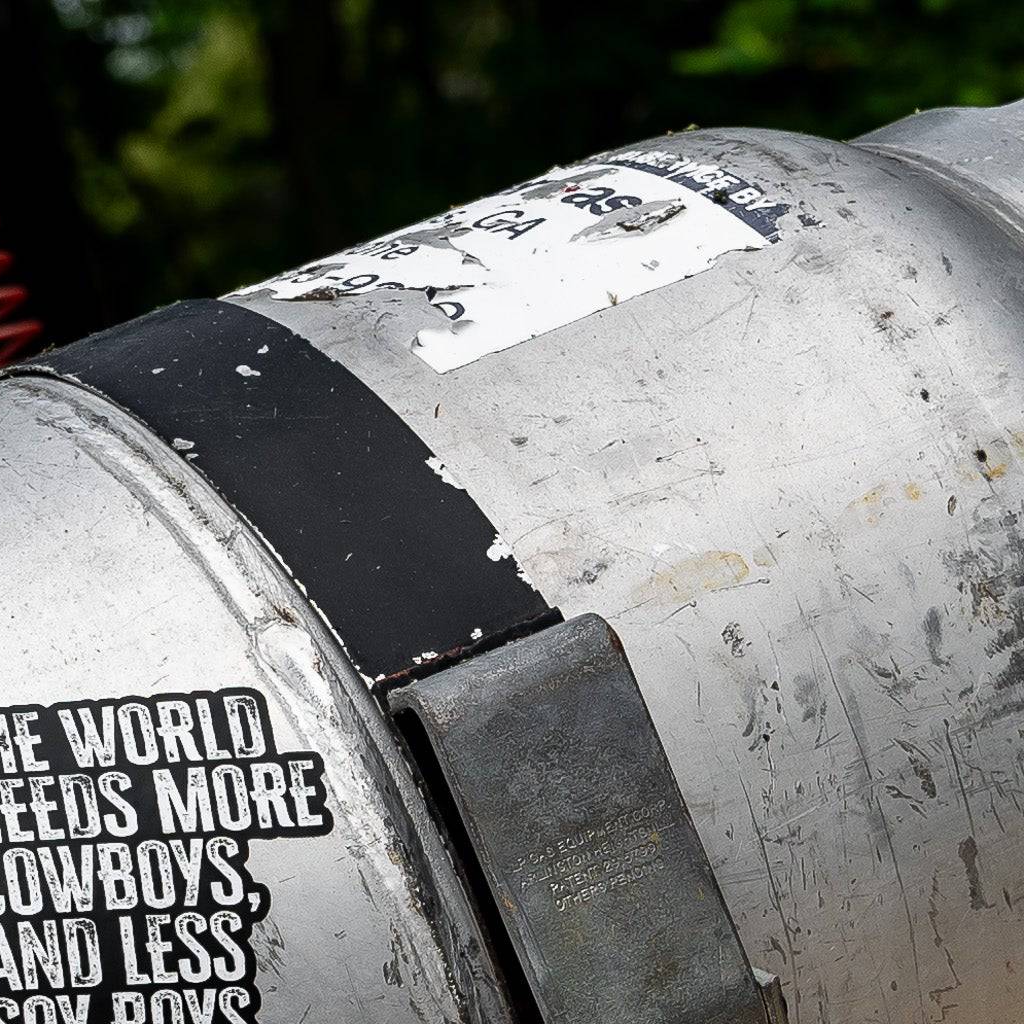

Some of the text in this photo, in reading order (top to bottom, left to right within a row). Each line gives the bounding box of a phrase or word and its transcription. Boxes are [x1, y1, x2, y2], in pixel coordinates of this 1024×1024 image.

[728, 187, 778, 211] BY
[58, 695, 266, 767] WORLD
[153, 759, 323, 833] MORE
[119, 911, 246, 984] LESS
